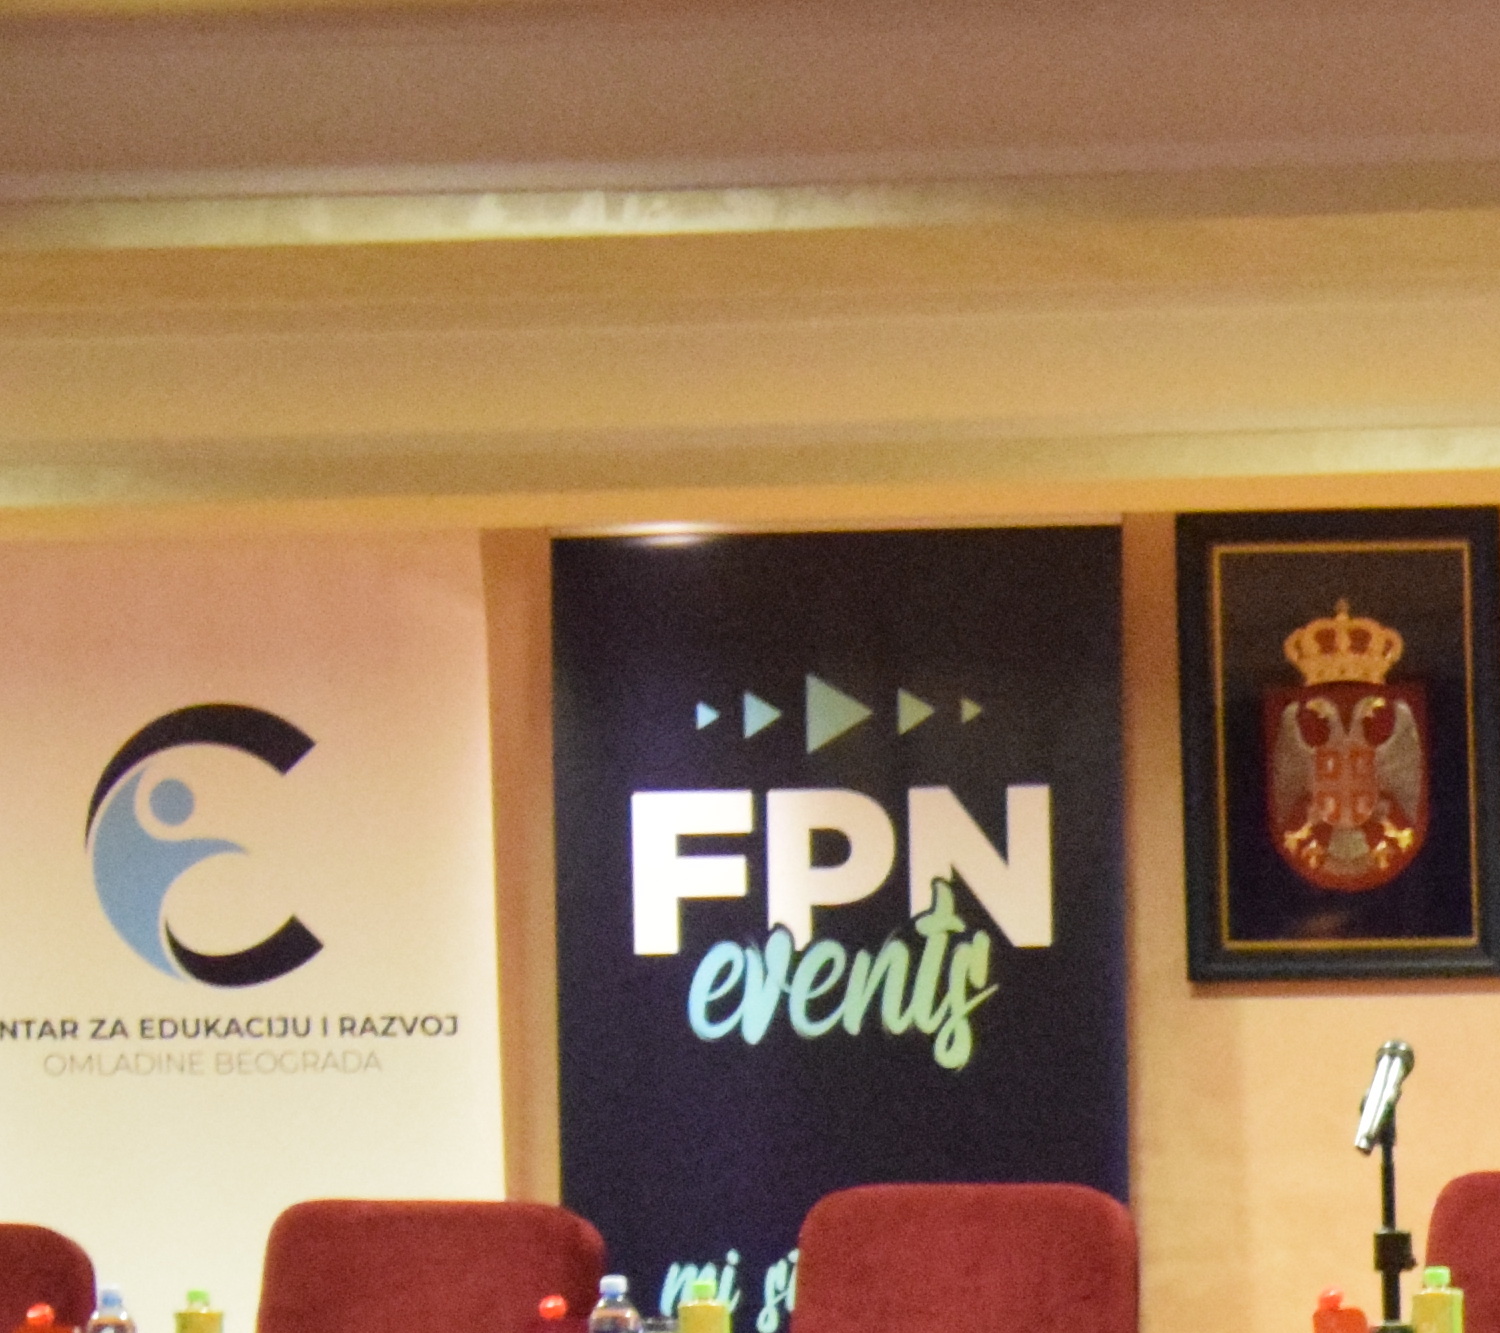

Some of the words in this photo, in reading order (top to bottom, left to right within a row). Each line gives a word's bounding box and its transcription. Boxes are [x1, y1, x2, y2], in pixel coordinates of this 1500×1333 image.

[631, 785, 1054, 956] FPN
[687, 880, 1000, 1070] events
[43, 1051, 204, 1077] OMLADINE
[216, 1049, 383, 1075] BEOGRADA
[89, 1018, 129, 1040] ZA
[140, 1016, 312, 1040] EDUKACIJU
[322, 1017, 329, 1037] I
[339, 1015, 459, 1038] RAZVOJ
